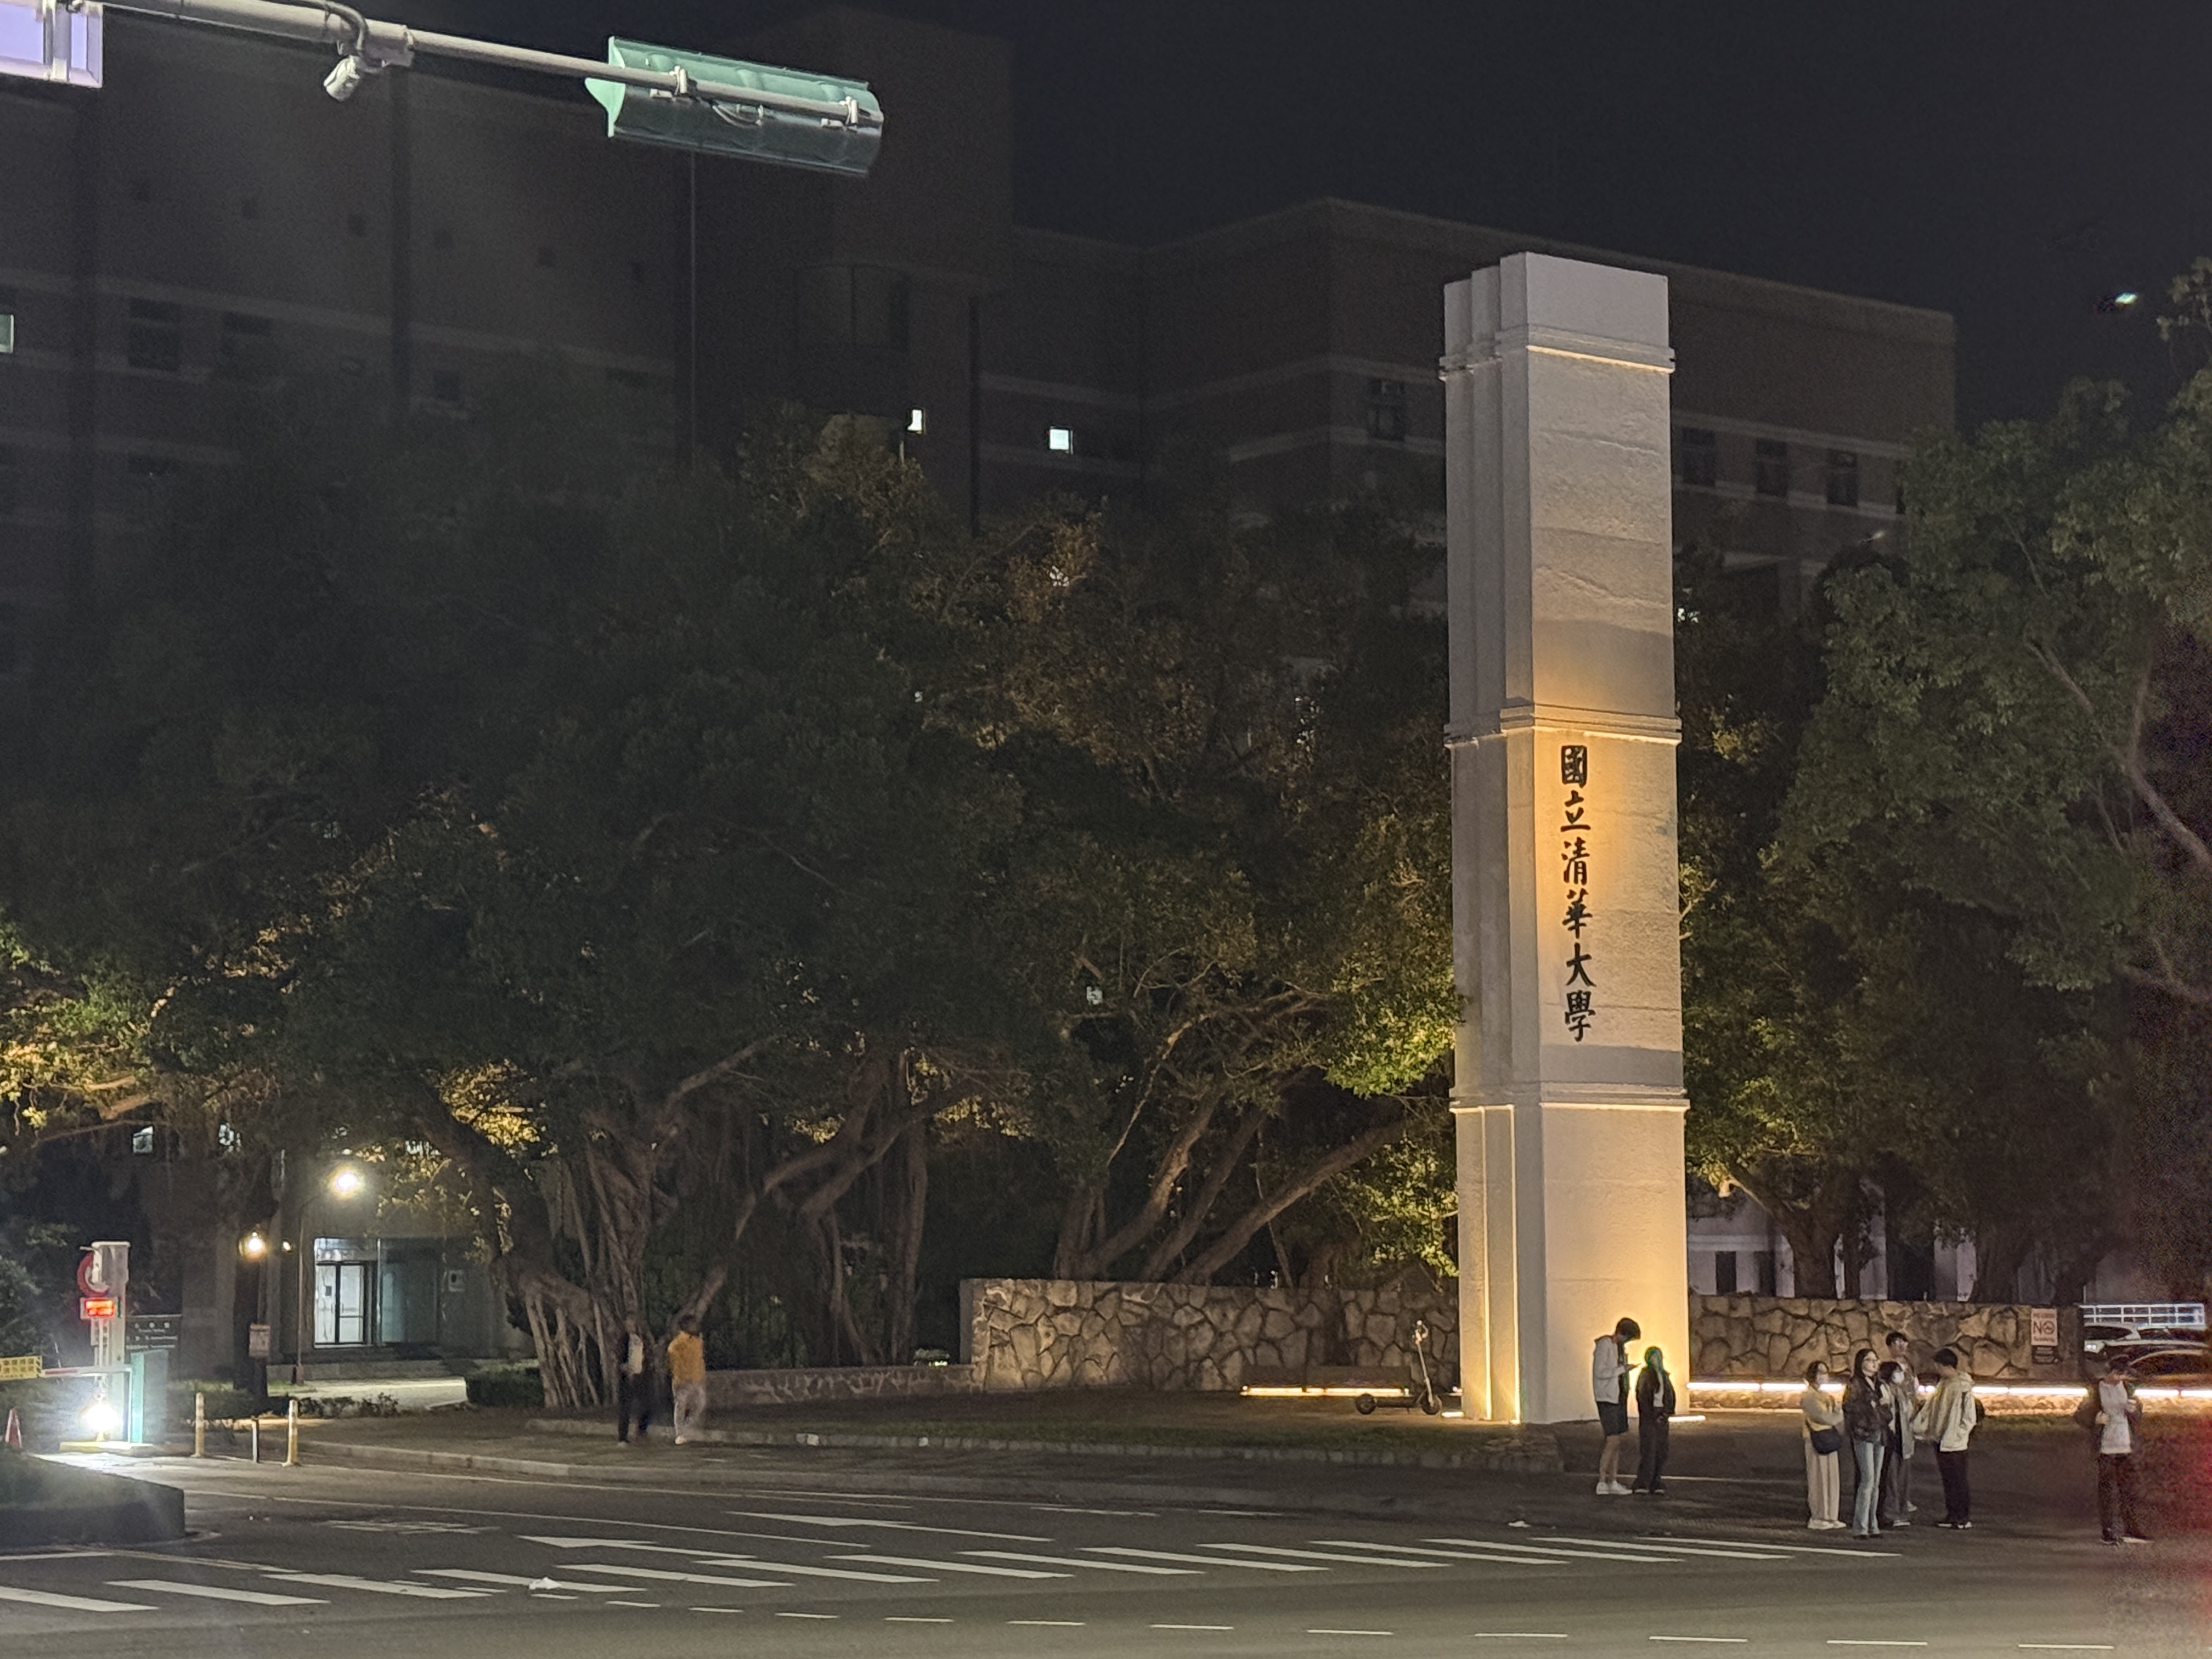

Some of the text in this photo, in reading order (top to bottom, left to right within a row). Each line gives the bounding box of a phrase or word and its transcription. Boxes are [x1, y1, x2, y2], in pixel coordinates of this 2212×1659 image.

[1561, 745, 1596, 1042] 國立清華大學
